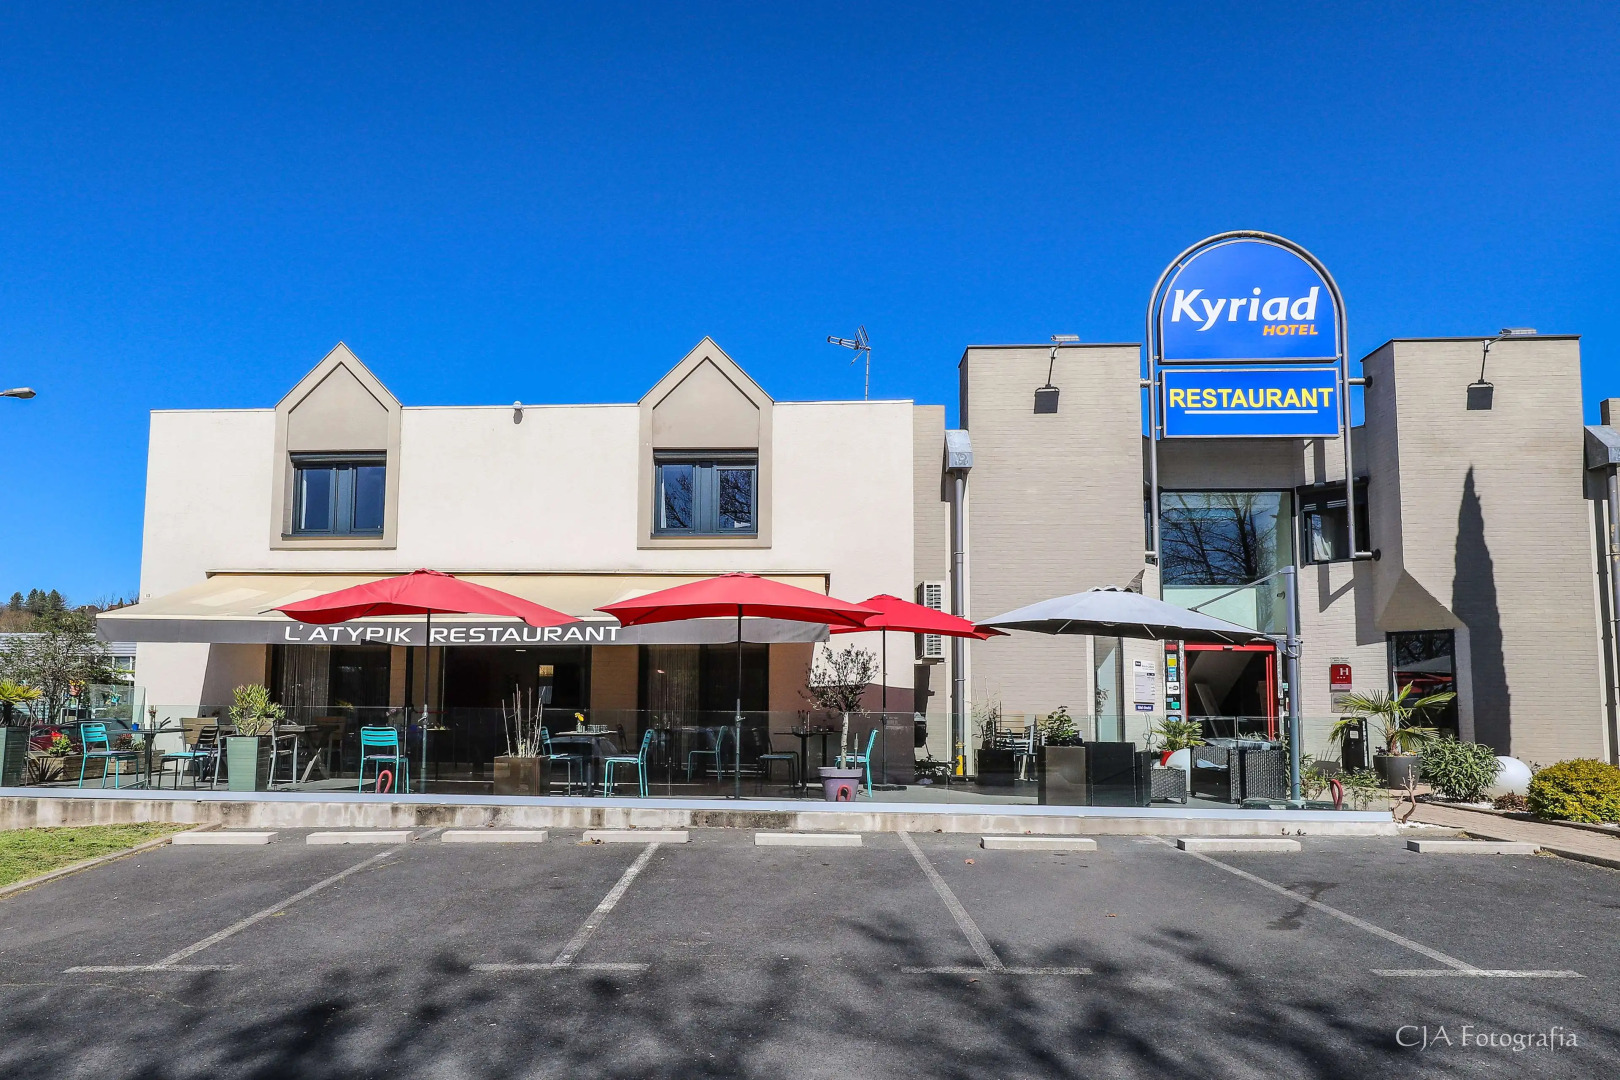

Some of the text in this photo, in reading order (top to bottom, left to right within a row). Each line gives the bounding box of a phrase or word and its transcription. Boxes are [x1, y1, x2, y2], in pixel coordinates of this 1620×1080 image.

[1171, 286, 1320, 332] Kyriad
[1262, 324, 1318, 336] HOTEL
[1169, 387, 1334, 408] RESTAURANT
[284, 624, 622, 643] L'ATYPIK RESTAURANT
[1339, 667, 1349, 676] H
